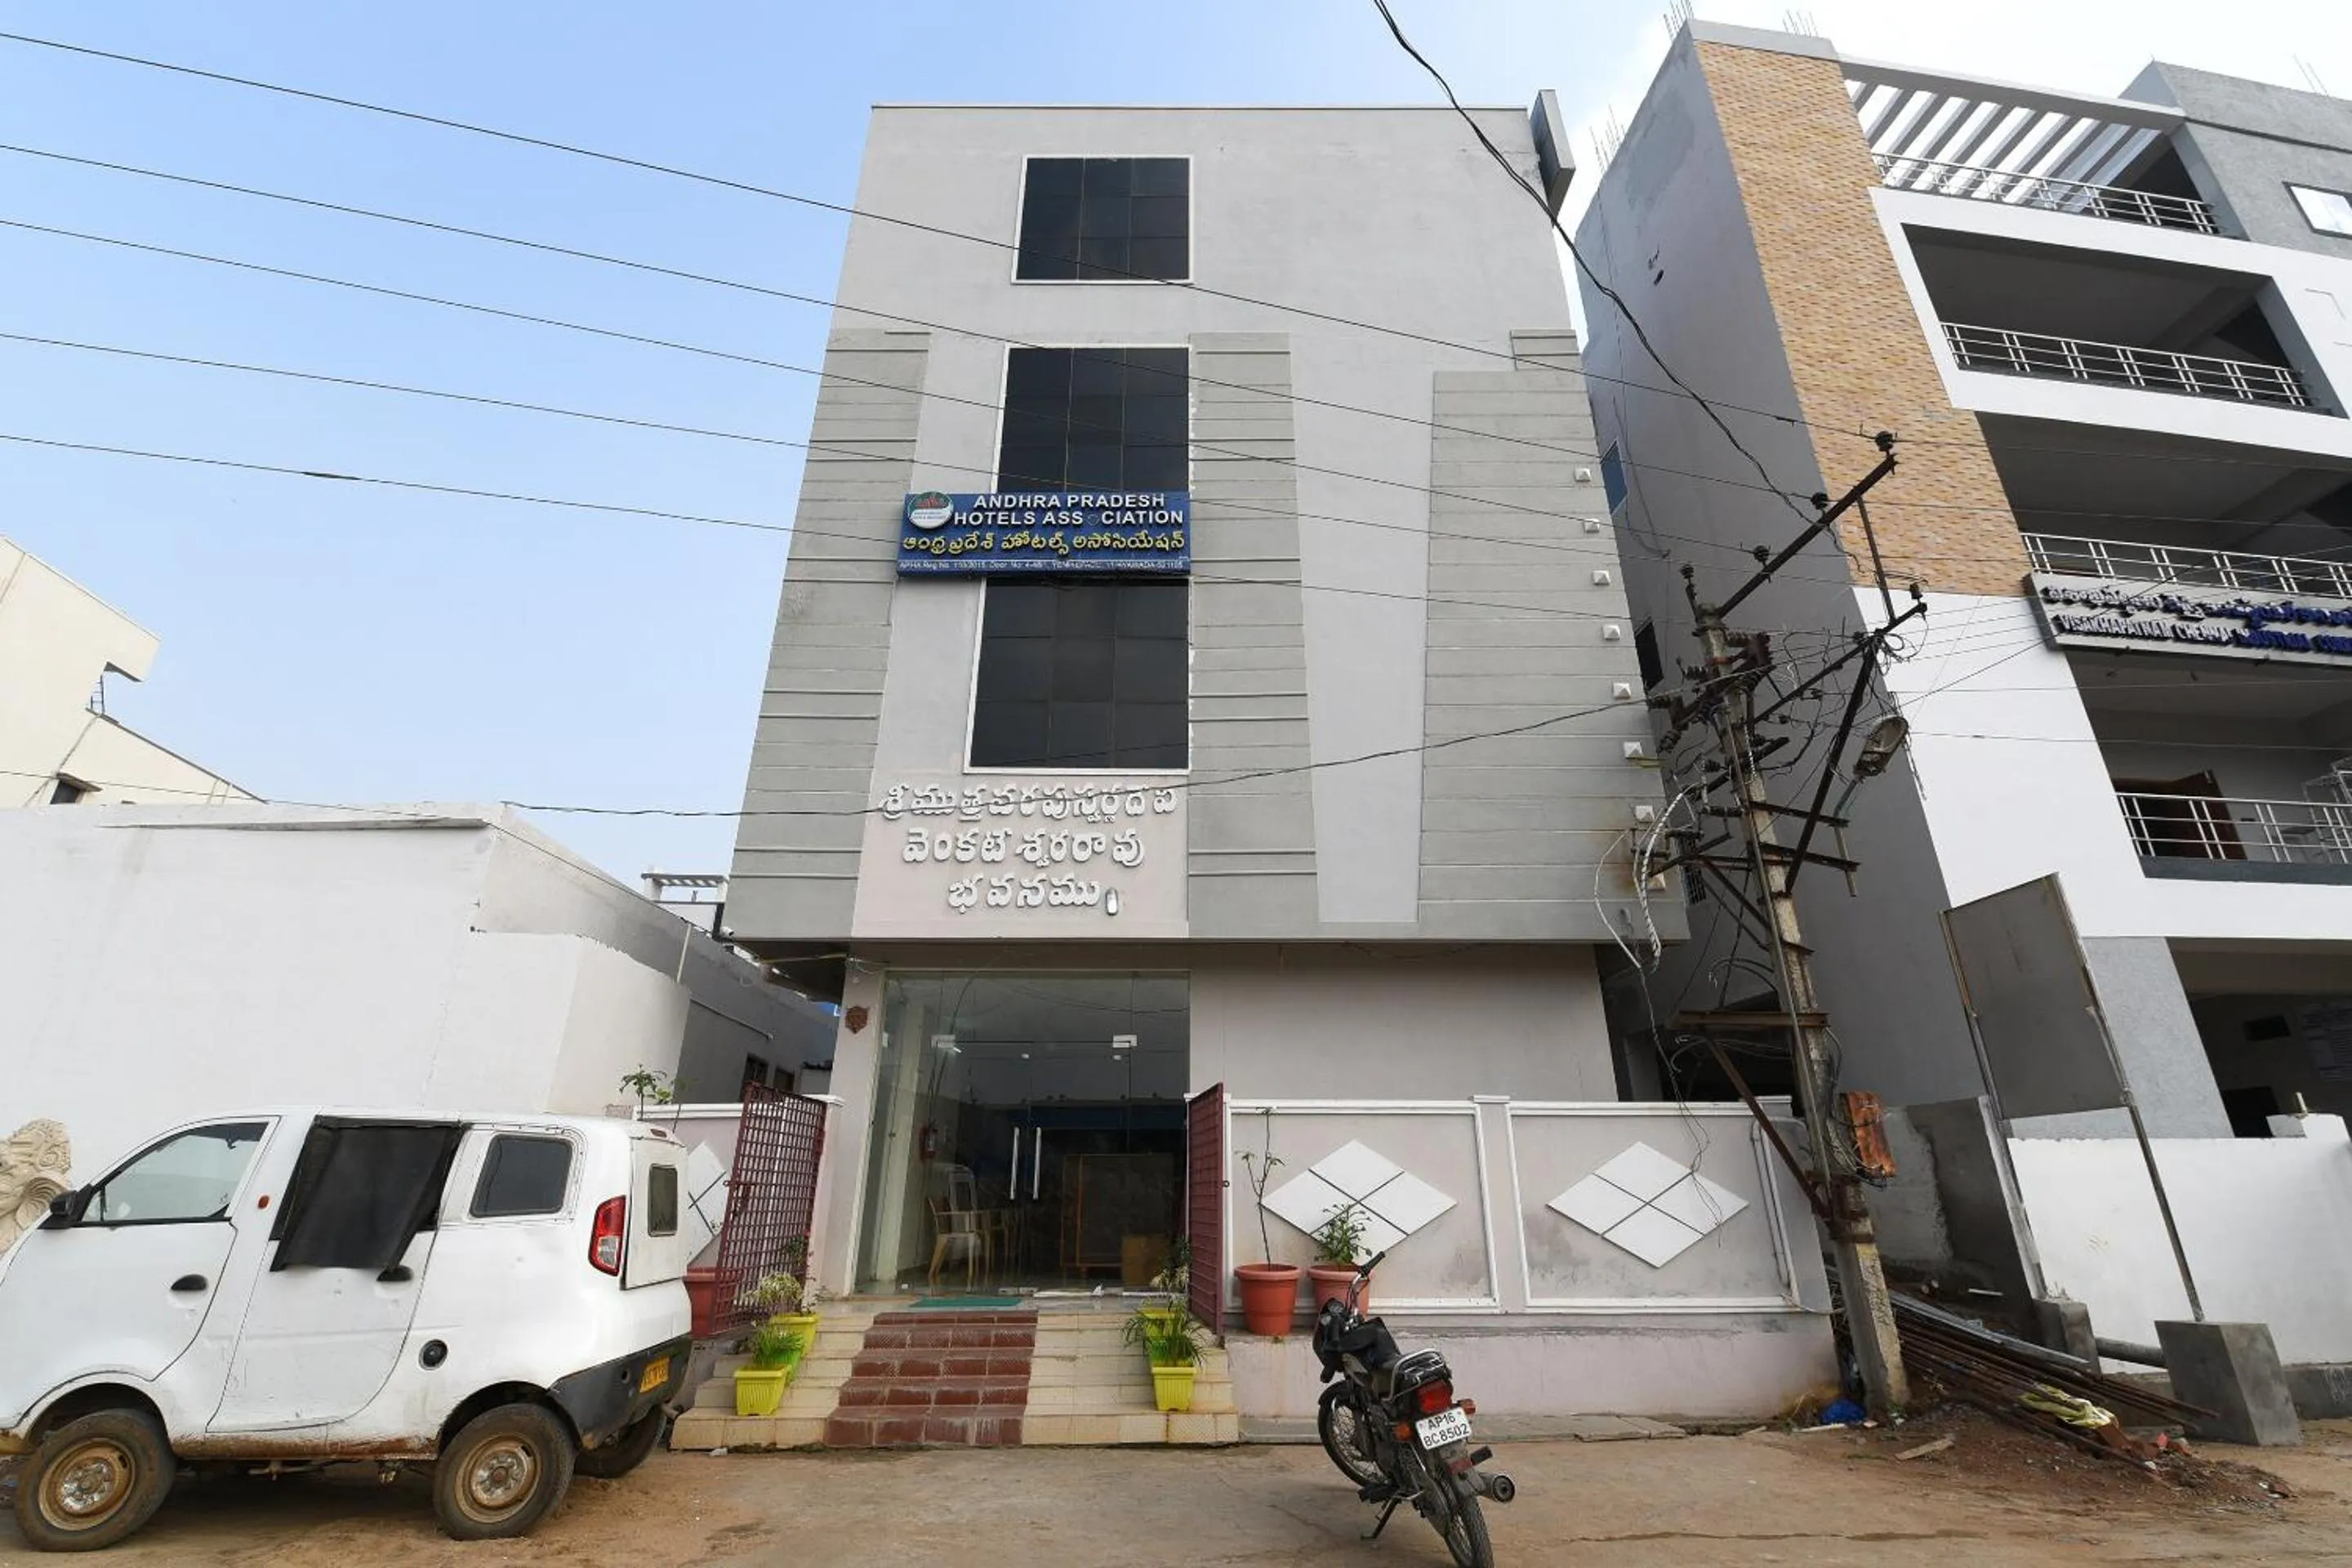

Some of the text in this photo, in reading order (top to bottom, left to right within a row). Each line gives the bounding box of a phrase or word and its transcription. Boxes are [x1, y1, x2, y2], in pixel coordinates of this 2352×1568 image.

[973, 493, 1165, 509] ANDHRA PRADESH
[954, 511, 1036, 526] HOTELS
[2059, 613, 2173, 638] VISAKHAPATNAM
[1428, 1413, 1455, 1429] AP16
